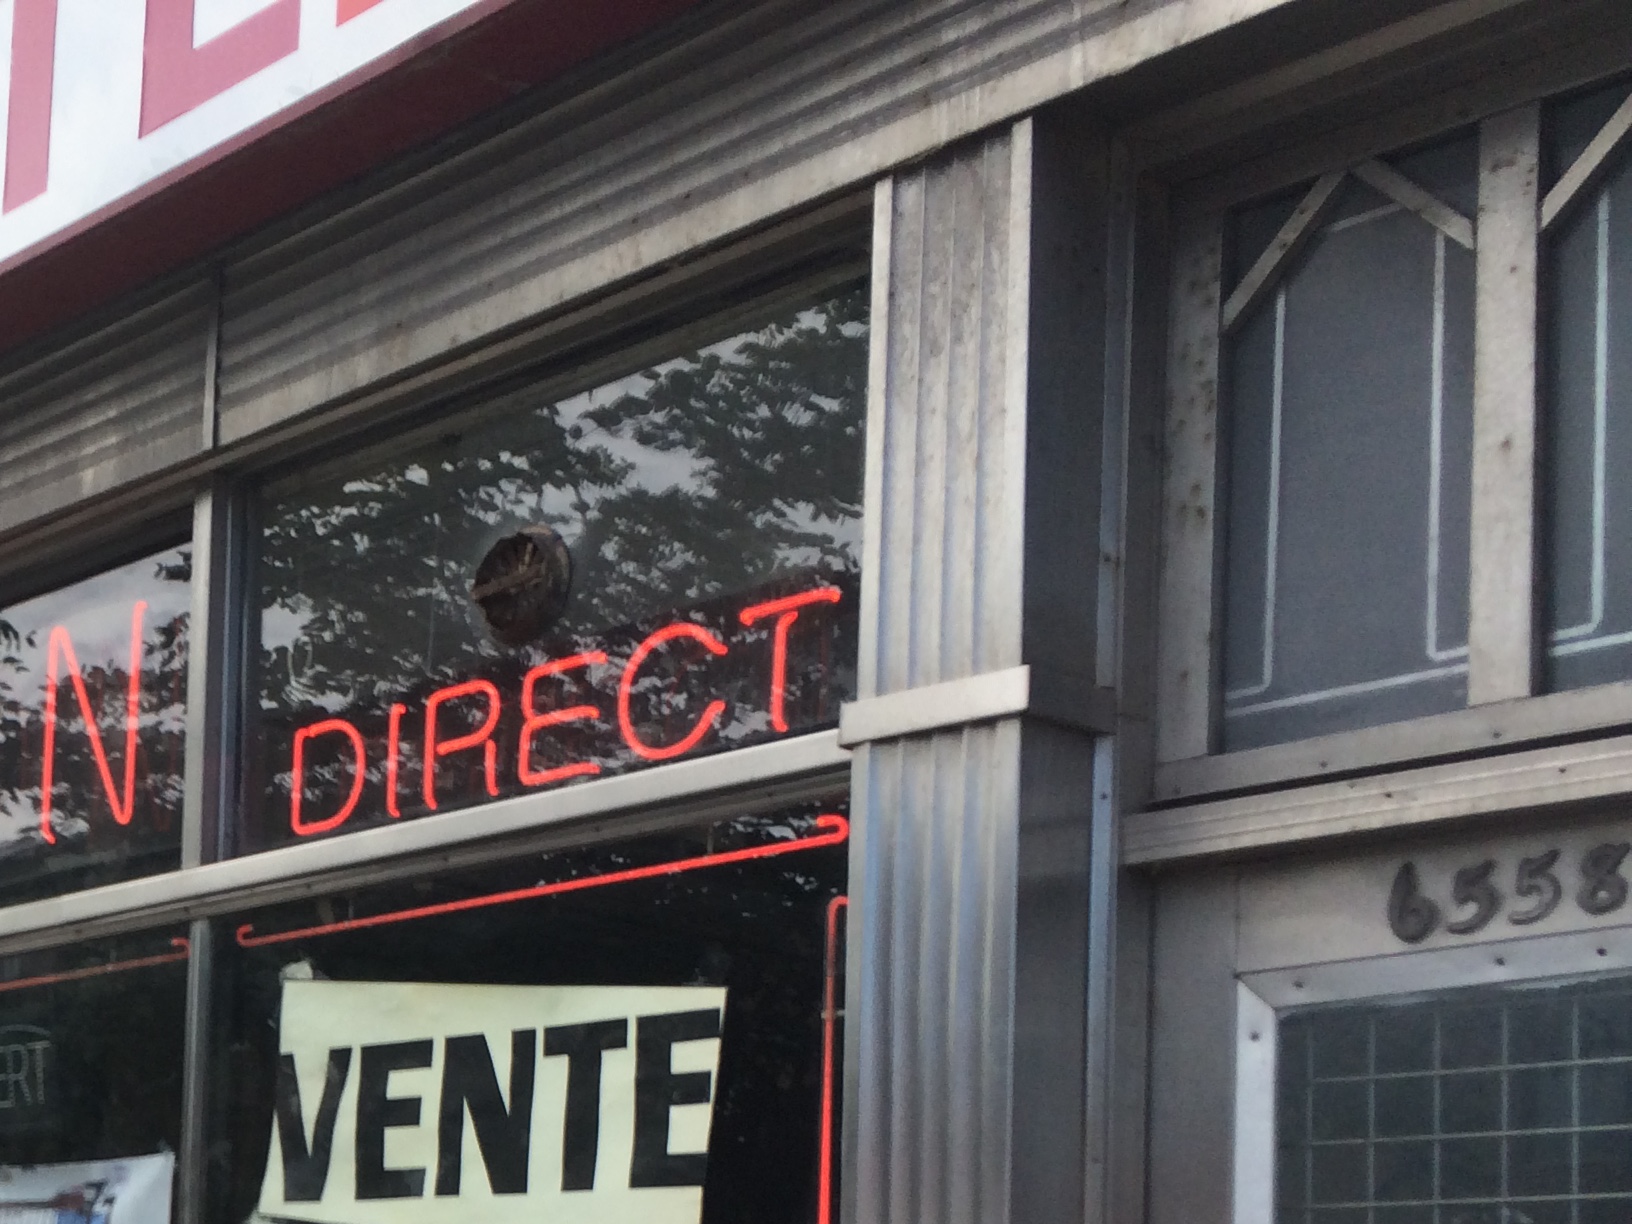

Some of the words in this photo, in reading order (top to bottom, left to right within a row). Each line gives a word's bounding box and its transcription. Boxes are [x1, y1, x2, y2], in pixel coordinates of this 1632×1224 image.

[291, 587, 841, 837] DIRECT
[1387, 841, 1632, 944] 6558
[275, 1007, 721, 1202] VENTE
